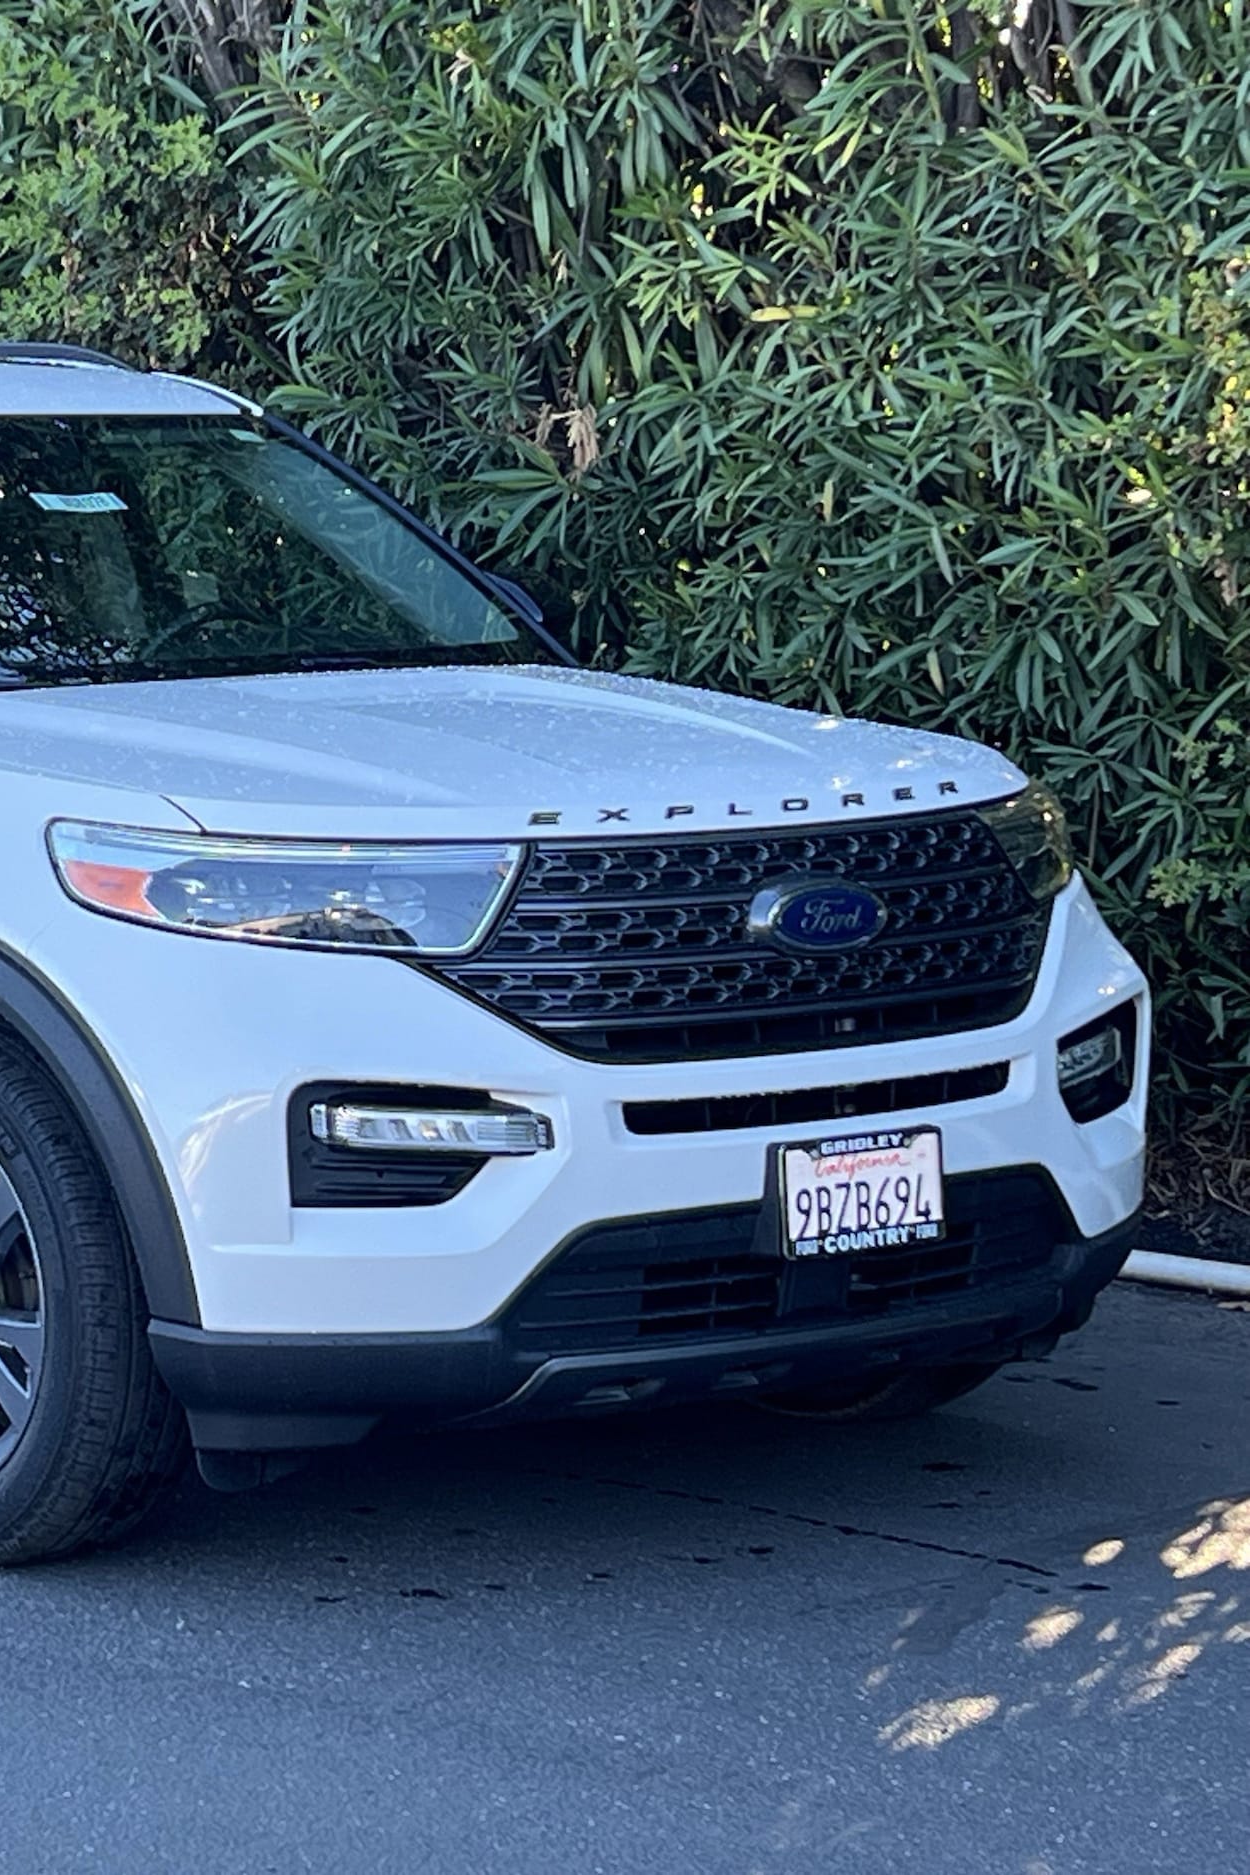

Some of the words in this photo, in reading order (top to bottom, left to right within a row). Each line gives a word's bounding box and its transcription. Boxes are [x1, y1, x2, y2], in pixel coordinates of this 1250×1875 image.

[529, 781, 958, 825] EXPLORER
[801, 897, 862, 934] Ford
[820, 1133, 904, 1154] GRIDLEY
[814, 1153, 911, 1179] California
[796, 1174, 931, 1240] 9BZB694
[824, 1227, 911, 1253] COUNTRY
